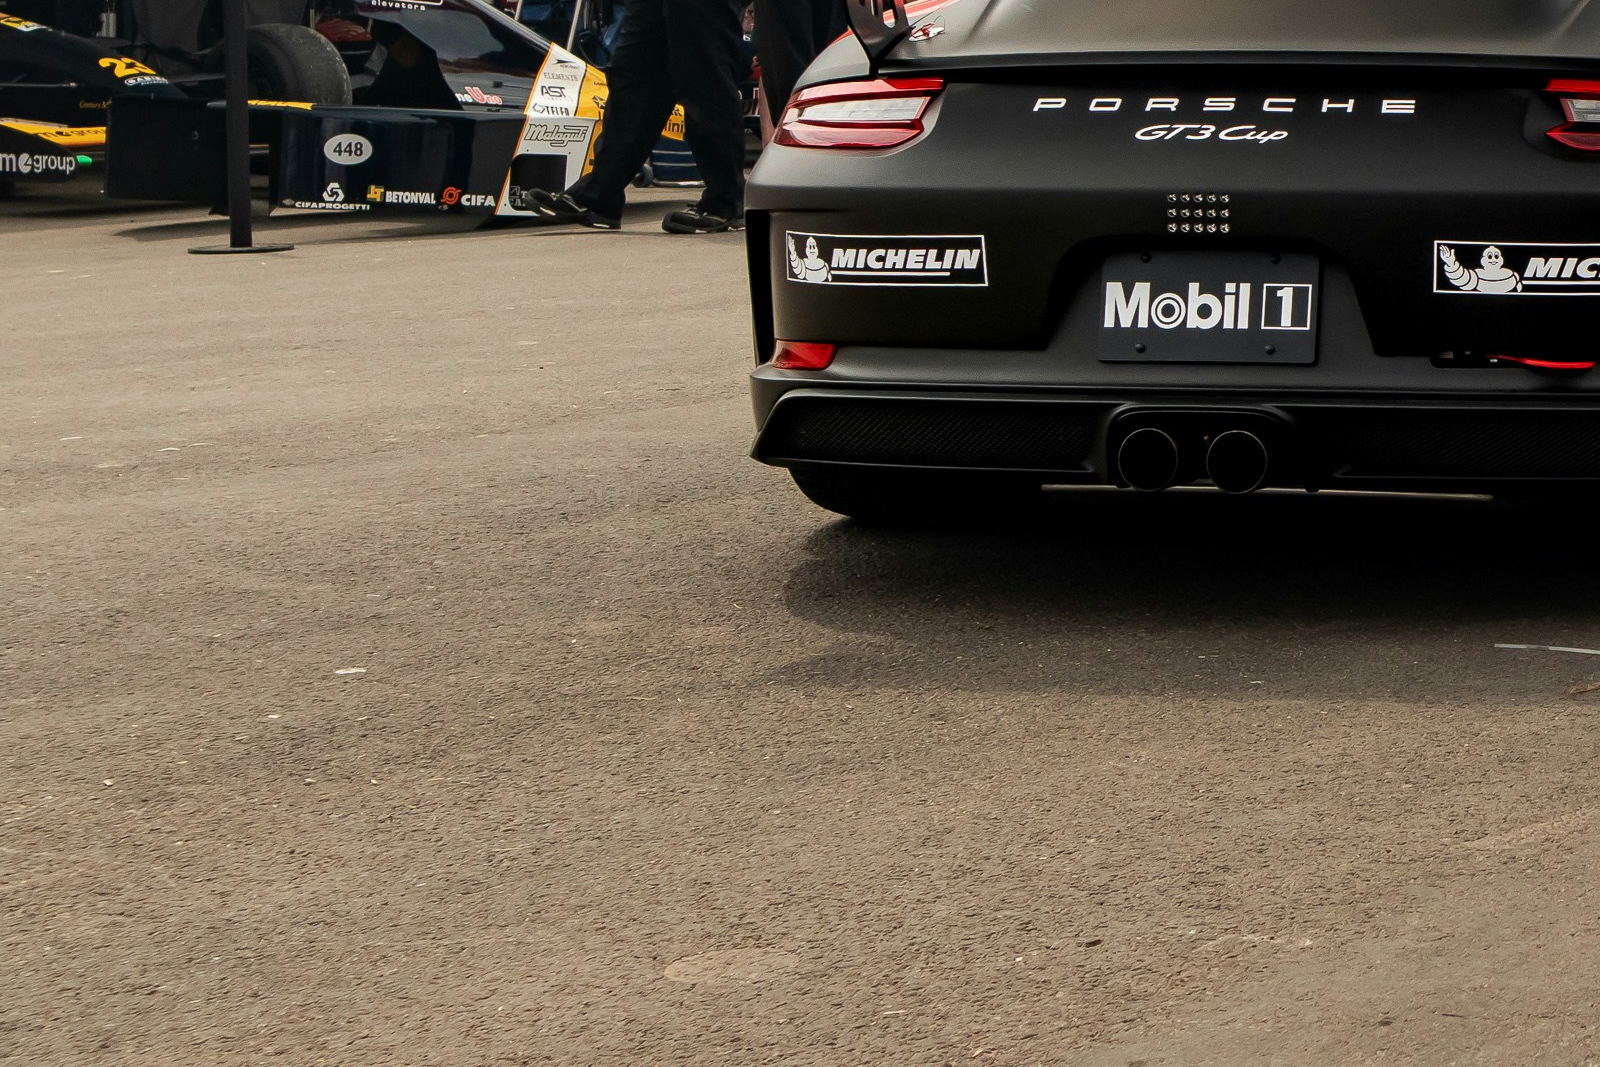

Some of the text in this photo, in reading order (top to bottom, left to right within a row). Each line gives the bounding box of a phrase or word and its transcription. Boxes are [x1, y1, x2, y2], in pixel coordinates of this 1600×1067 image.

[371, 0, 426, 11] elevators
[543, 71, 579, 82] ELEMENTS
[1032, 97, 1416, 113] PORSCHE
[524, 123, 589, 148] Malaguti
[1134, 124, 1289, 144] GT3 Cup
[333, 141, 364, 157] 448
[385, 190, 436, 205] BETONVAL
[460, 194, 496, 207] CIFA
[295, 201, 371, 211] CIFAPROGETTI
[830, 248, 981, 271] MICHELIN
[1103, 282, 1251, 330] Mobil
